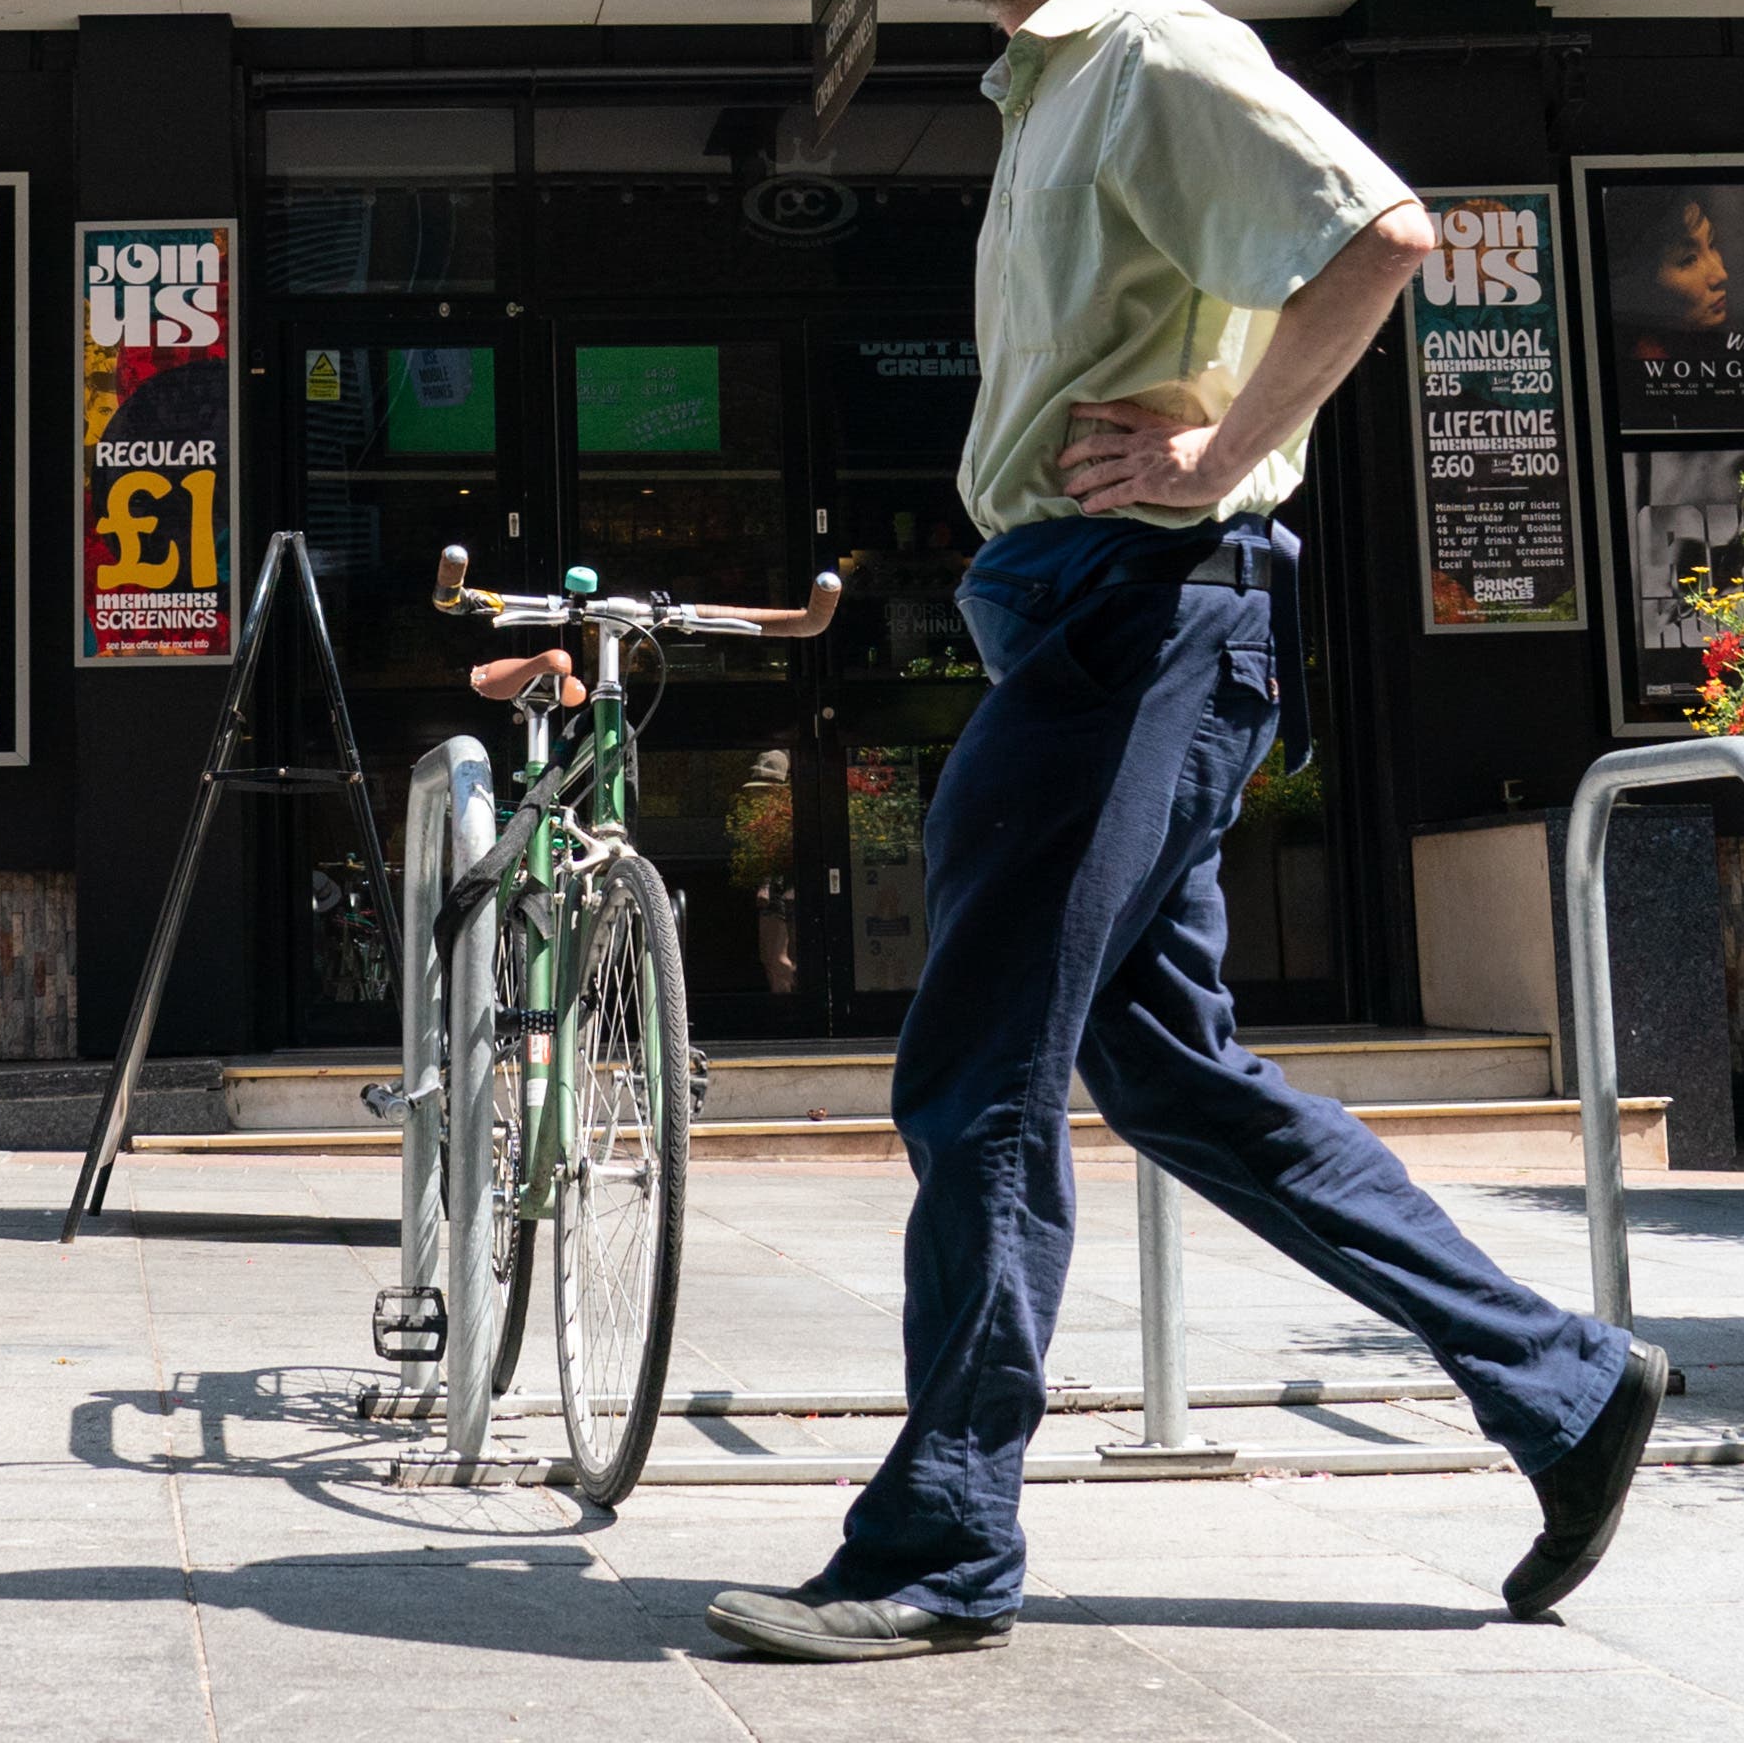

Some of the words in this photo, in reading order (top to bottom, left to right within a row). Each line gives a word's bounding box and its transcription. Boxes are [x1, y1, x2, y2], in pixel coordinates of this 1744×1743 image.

[1423, 328, 1551, 359] ANNUAL
[875, 358, 979, 377] GREML
[1423, 357, 1552, 373] MEMBERSHIP
[1644, 360, 1743, 378] WONG
[1425, 373, 1462, 397] £15
[1510, 371, 1554, 394] £20
[1428, 408, 1557, 437] LIFETIME
[1429, 436, 1558, 451] MEMBERSHIP
[95, 440, 217, 468] REGULAR
[1431, 454, 1475, 478] £60
[1510, 452, 1560, 476] £100
[1435, 502, 1476, 512] Minimum
[1479, 502, 1505, 512] £2.50
[1508, 501, 1527, 511] OFF
[1529, 500, 1561, 510] tickets
[1435, 515, 1448, 524] £6
[1464, 513, 1503, 523] Weekday
[1521, 512, 1562, 521] matinees
[95, 469, 219, 590] £1
[1455, 525, 1477, 535] Hour
[1484, 525, 1519, 534] Priority
[1438, 537, 1456, 546] 15%
[1461, 536, 1479, 546] OFF
[1484, 536, 1513, 546] drinks
[1518, 536, 1527, 544] &
[1532, 535, 1563, 544] snacks
[1438, 548, 1473, 558] Regular
[1488, 548, 1499, 557] £1
[1438, 560, 1463, 569] Local
[1472, 559, 1512, 568] business
[1521, 558, 1565, 568] discounts
[1473, 576, 1535, 592] PRINCE
[95, 591, 219, 610] MEMBERS
[1473, 588, 1535, 603] CHARLES
[95, 609, 218, 630] SCREENINGS
[913, 618, 963, 633] MINU
[105, 641, 120, 650] see
[120, 640, 135, 650] box
[135, 640, 158, 650] office
[158, 639, 172, 649] for
[172, 640, 193, 649] more
[193, 639, 210, 648] info
